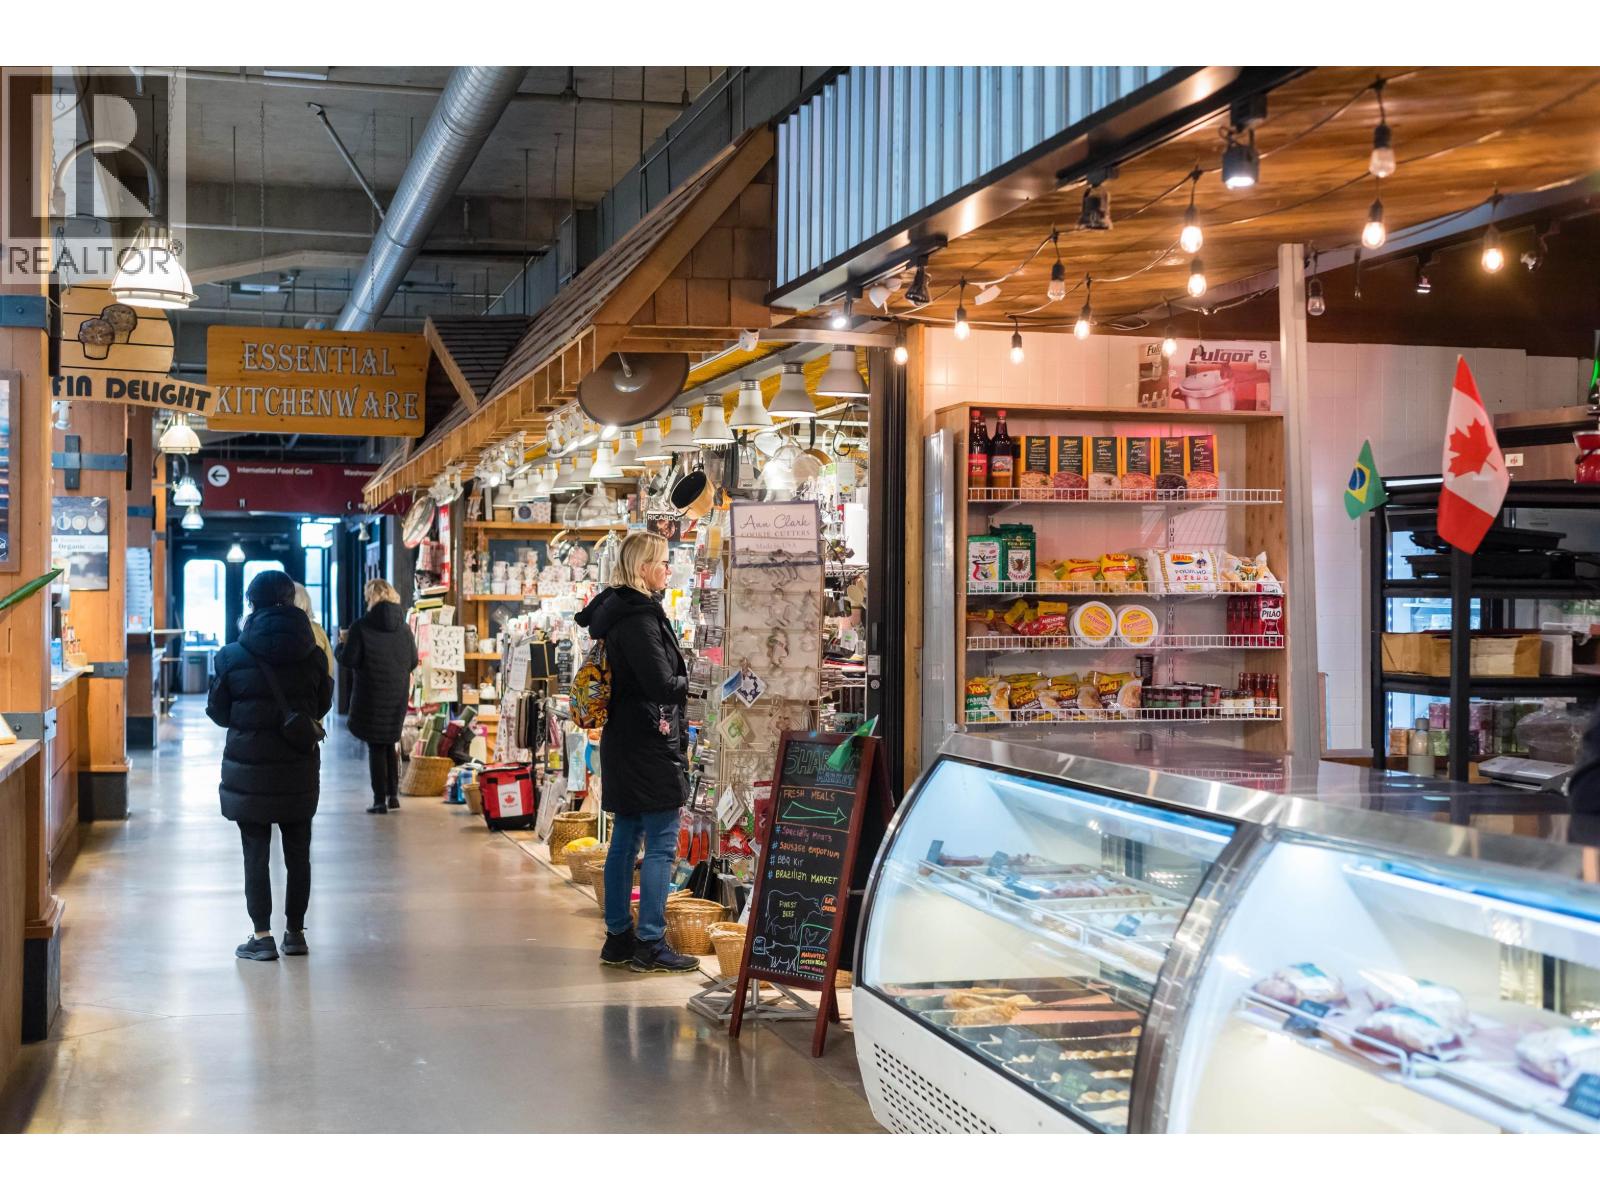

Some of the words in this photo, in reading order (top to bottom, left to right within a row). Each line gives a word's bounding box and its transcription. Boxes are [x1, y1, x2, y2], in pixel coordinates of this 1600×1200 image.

[242, 342, 397, 377] ESSENTIAL
[1258, 350, 1268, 359] 6
[105, 377, 212, 411] DELIGHT
[214, 384, 420, 425] KITCHENWARE
[237, 466, 276, 475] International
[294, 468, 313, 476] Court
[740, 514, 770, 530] Ann
[773, 513, 811, 529] Clark
[783, 788, 806, 799] FRESH
[811, 790, 836, 801] MEALS
[777, 855, 791, 866] BBQ
[810, 874, 839, 885] MARKET
